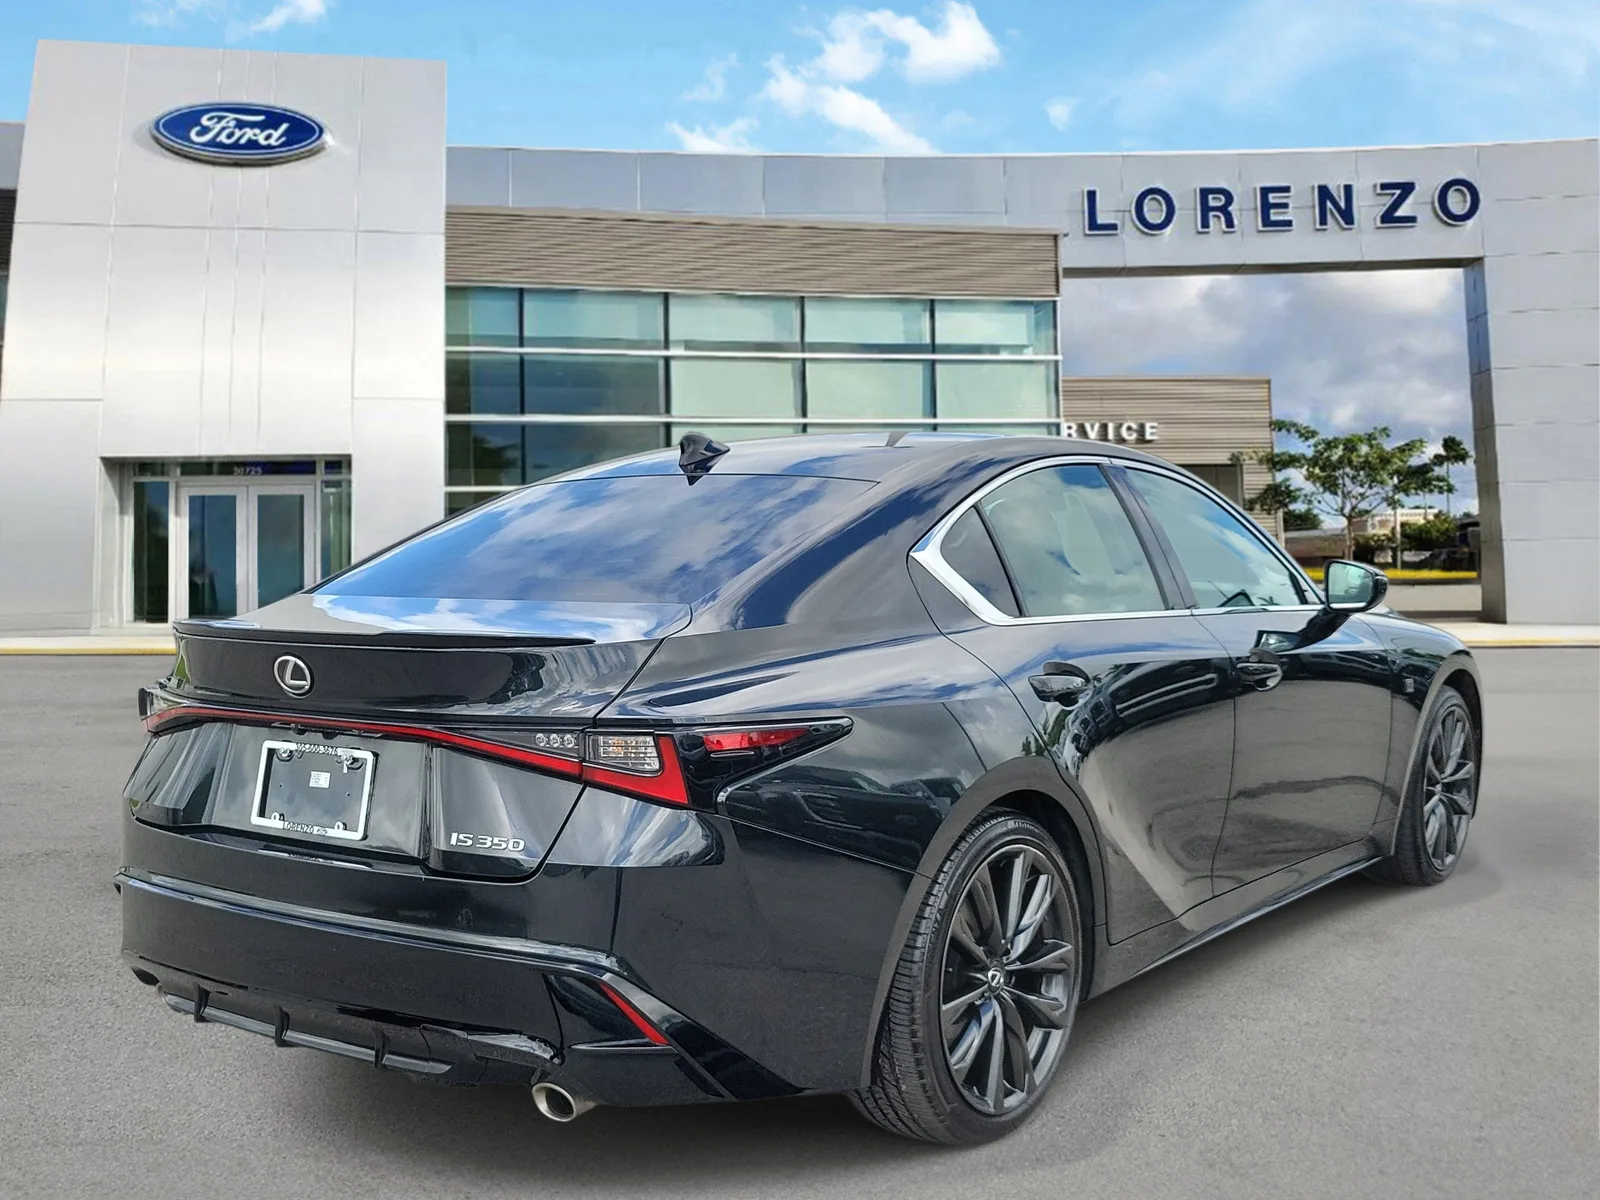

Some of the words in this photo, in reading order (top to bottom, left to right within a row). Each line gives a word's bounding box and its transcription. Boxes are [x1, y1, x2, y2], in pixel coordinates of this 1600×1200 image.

[189, 111, 290, 146] Ford
[1083, 178, 1481, 235] LORENZO
[450, 832, 474, 847] IS
[475, 835, 525, 852] 350
